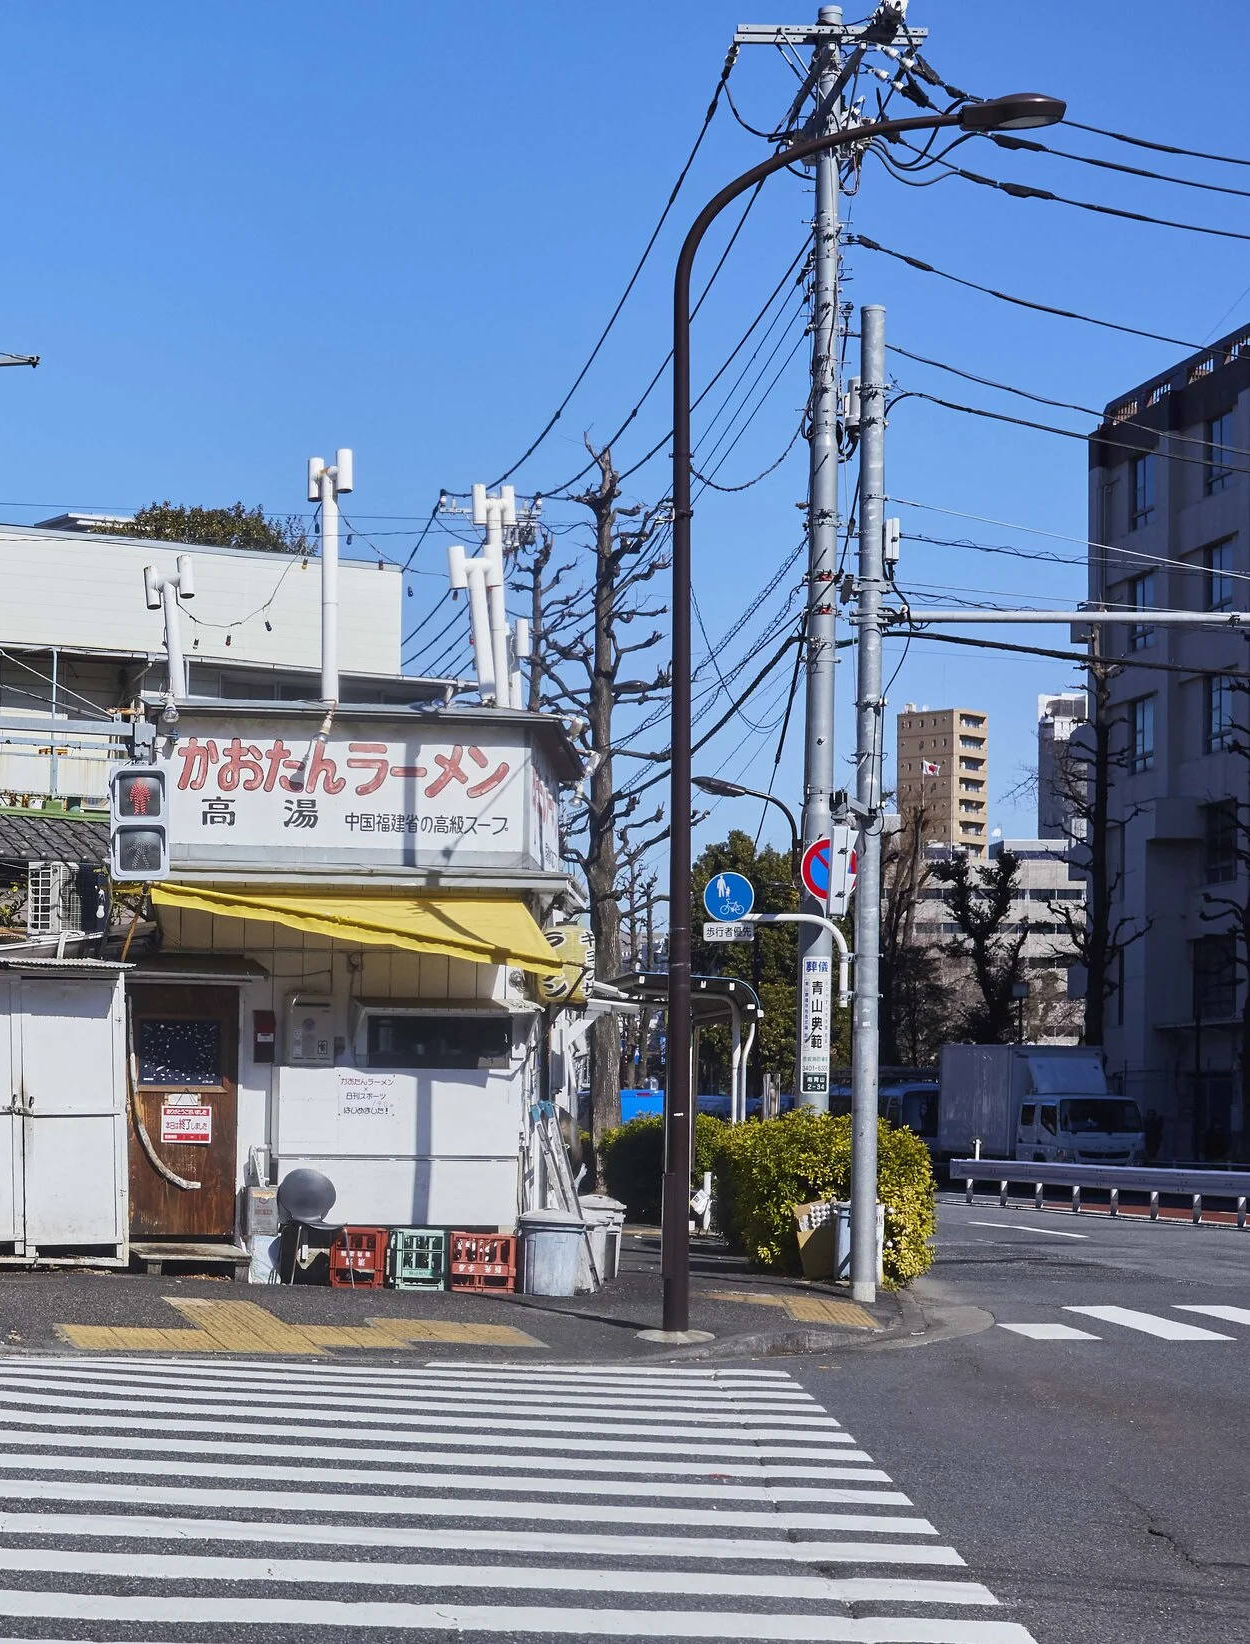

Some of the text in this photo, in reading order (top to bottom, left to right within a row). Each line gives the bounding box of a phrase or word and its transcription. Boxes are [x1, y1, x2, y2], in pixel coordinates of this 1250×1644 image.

[177, 736, 510, 799] かおたんラーメン
[201, 796, 319, 829] 高 湯
[706, 926, 752, 938] 歩行者優先
[805, 960, 829, 973] 葬儀
[810, 980, 824, 1049] 青山典範
[346, 1092, 387, 1100] 日刊スポーツ
[166, 1118, 208, 1131] 本日は終了しました
